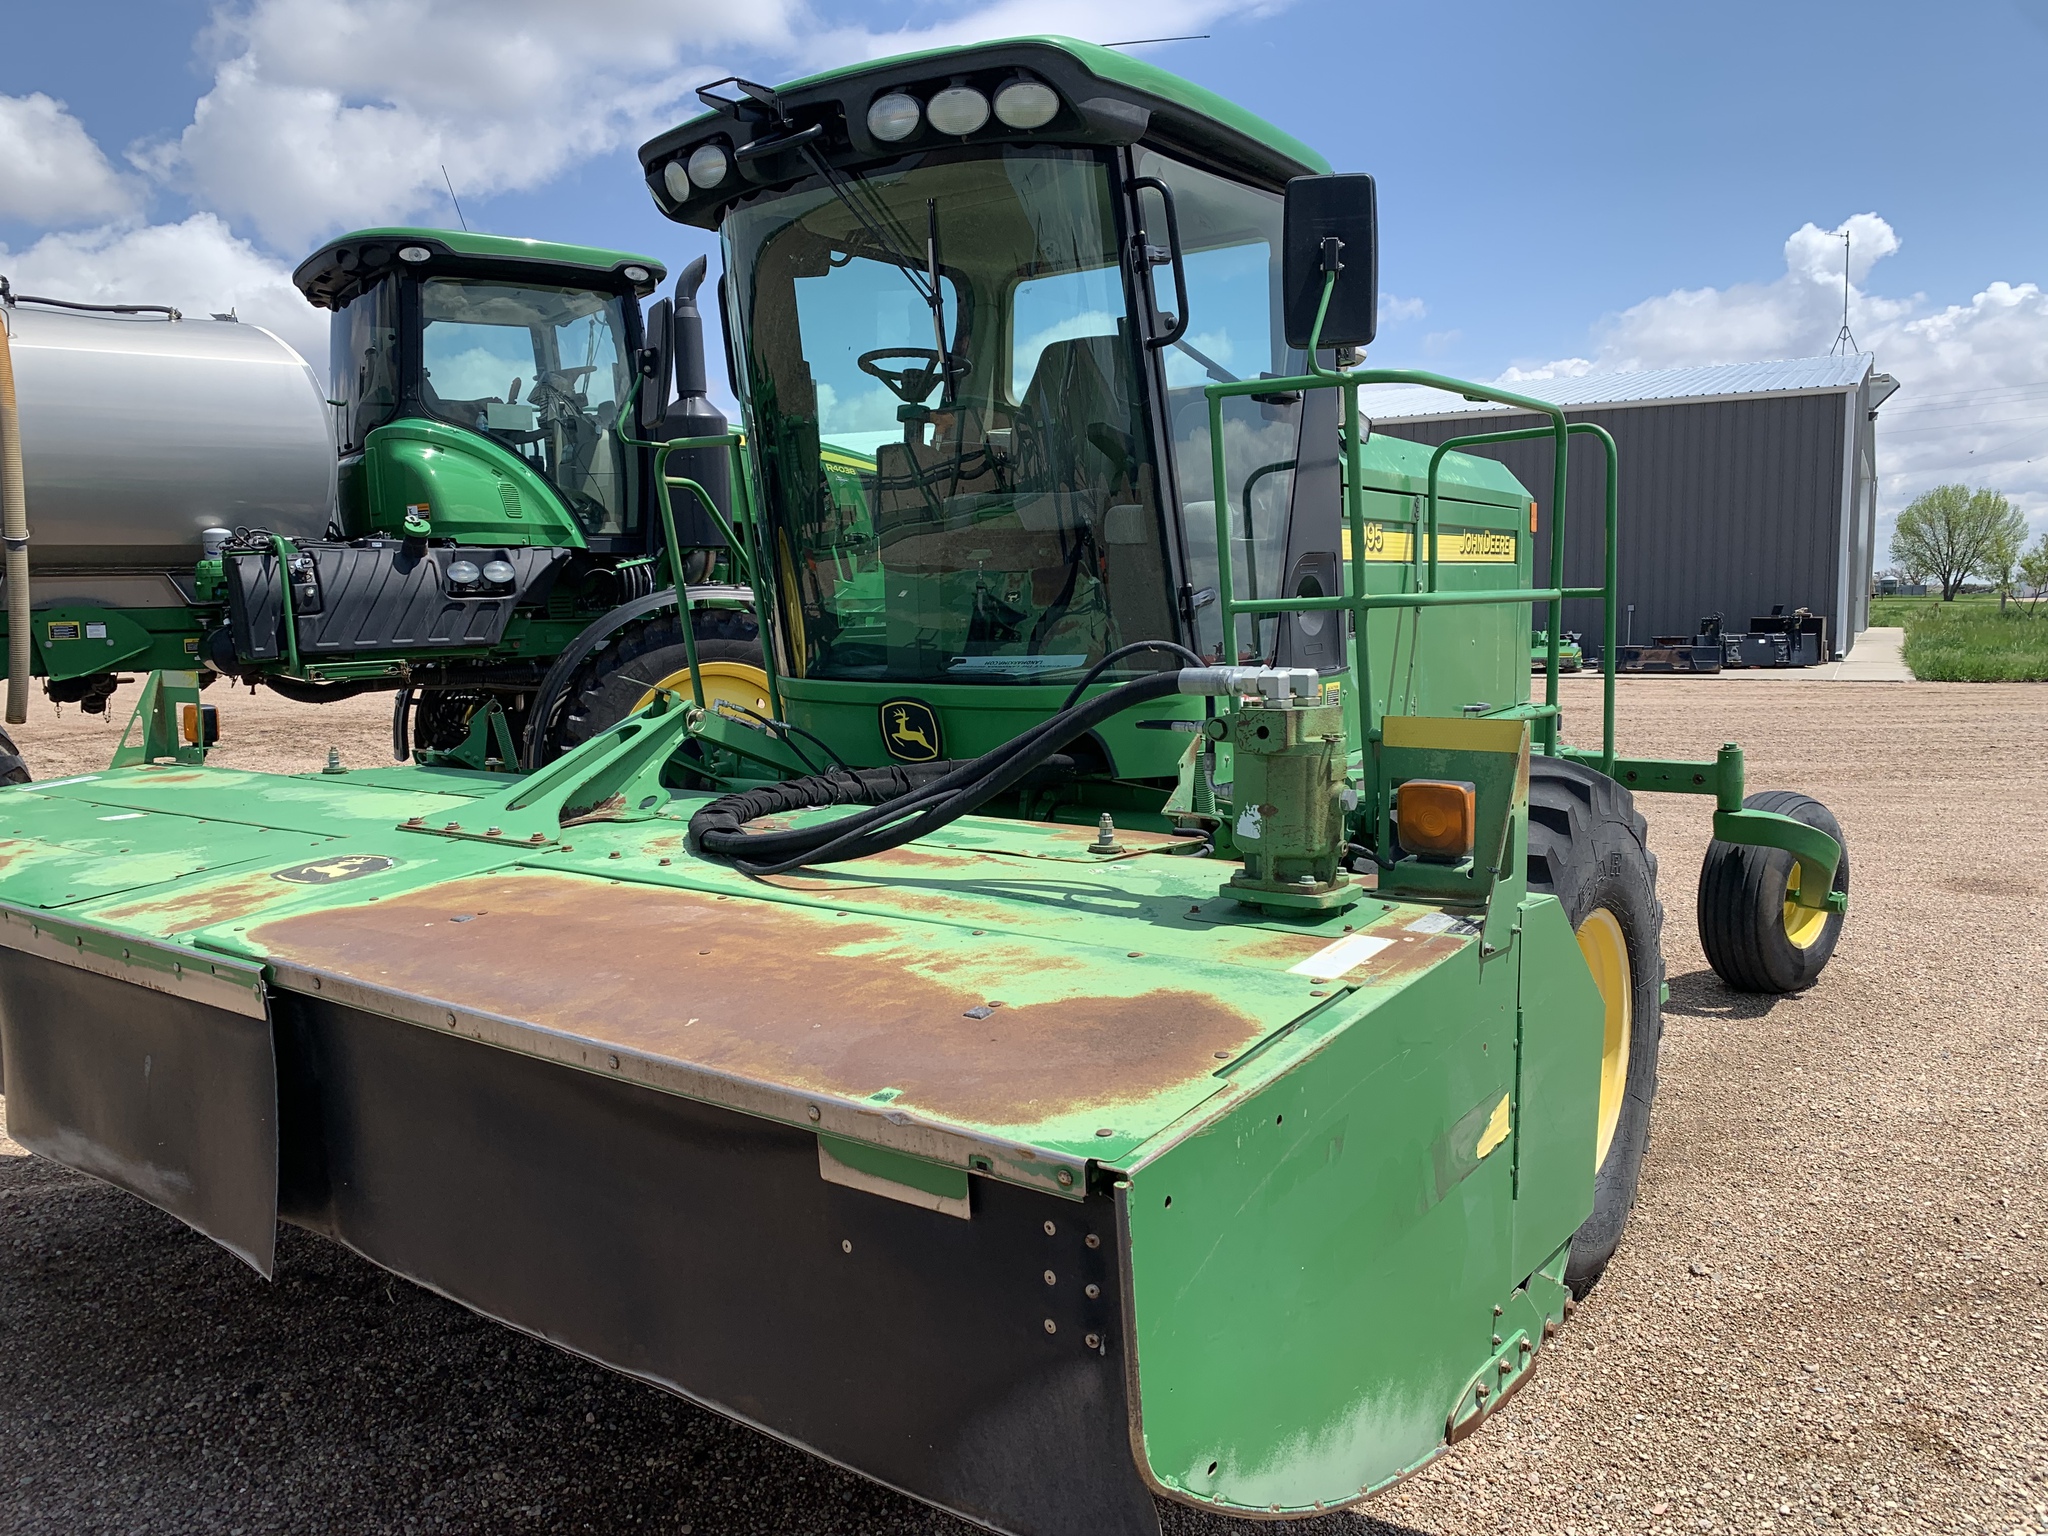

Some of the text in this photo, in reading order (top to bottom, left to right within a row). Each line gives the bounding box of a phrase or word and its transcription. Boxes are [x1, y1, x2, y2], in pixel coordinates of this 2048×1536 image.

[825, 463, 856, 475] R4038
[1363, 522, 1383, 551] 95
[1460, 529, 1509, 554] JOHN DEERE
